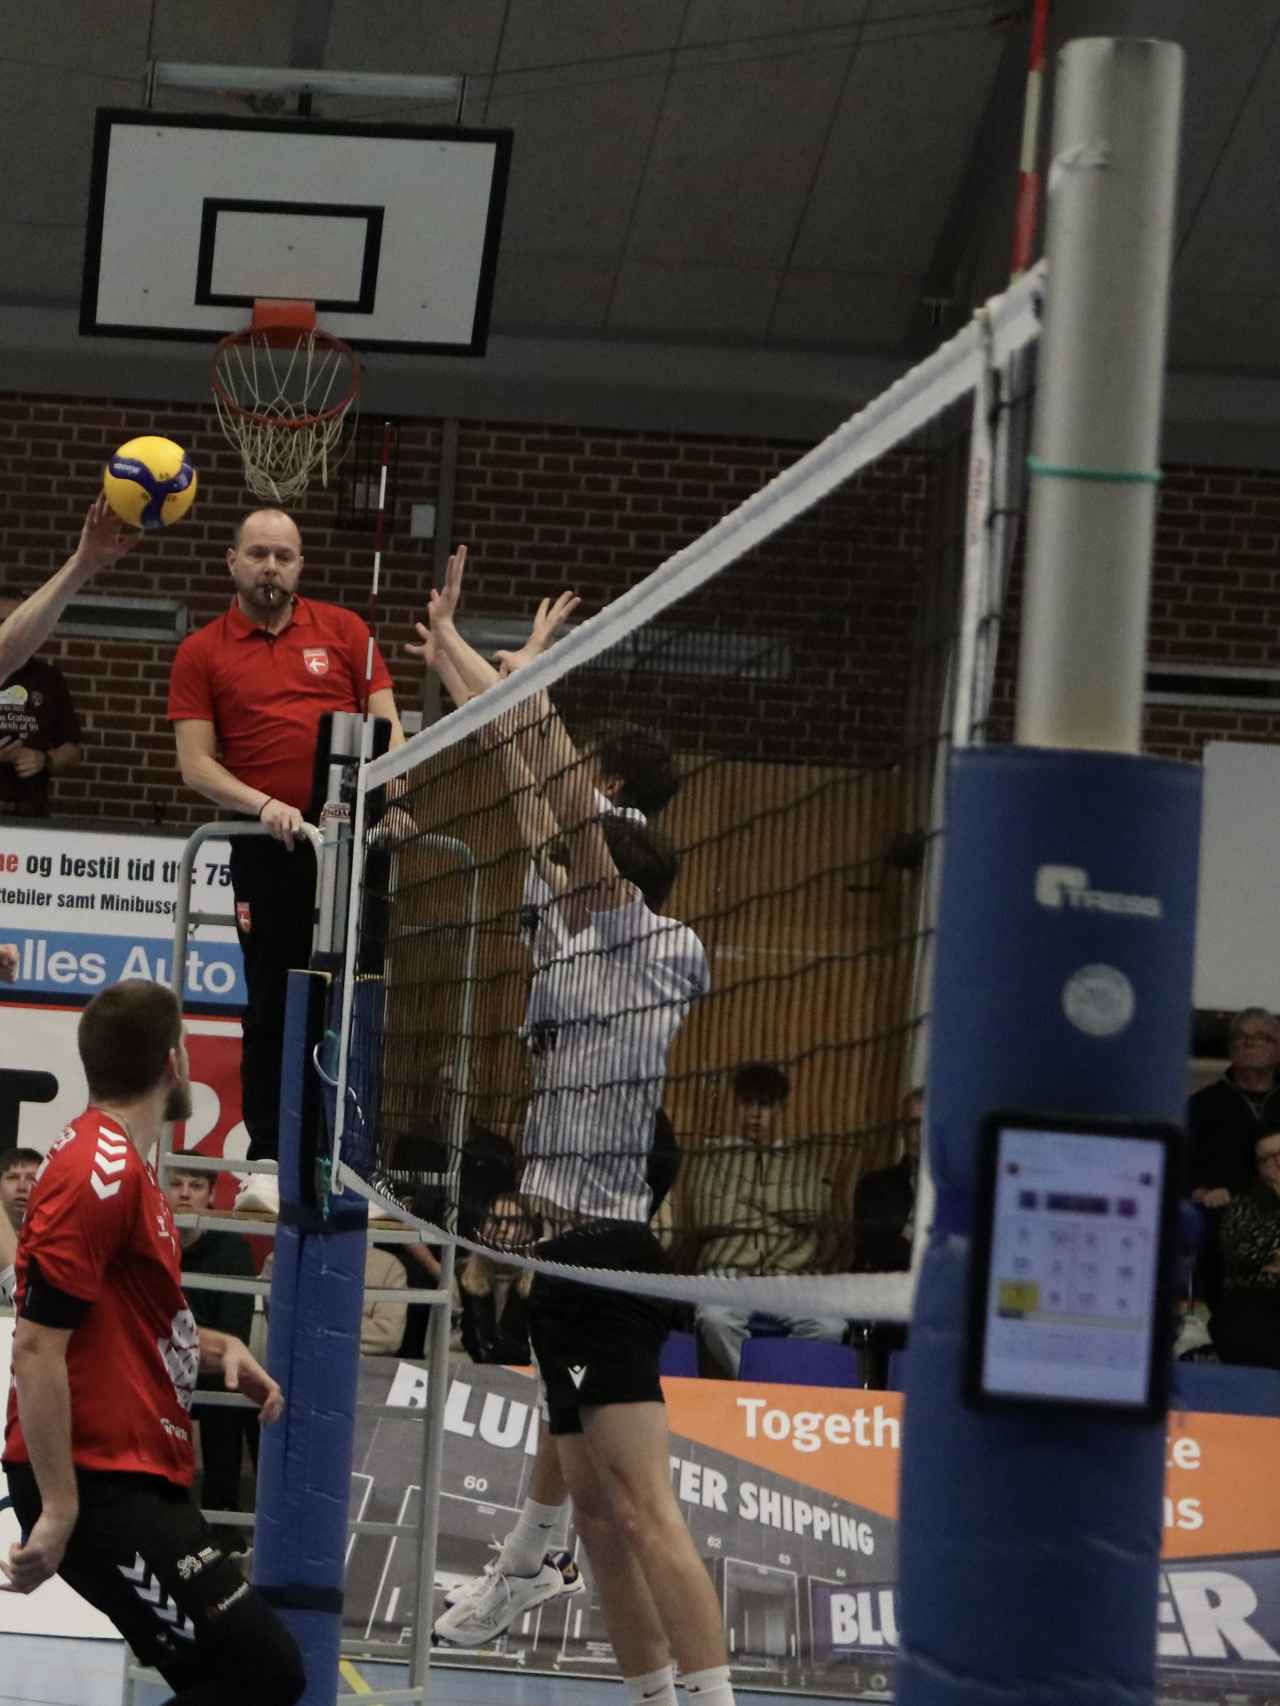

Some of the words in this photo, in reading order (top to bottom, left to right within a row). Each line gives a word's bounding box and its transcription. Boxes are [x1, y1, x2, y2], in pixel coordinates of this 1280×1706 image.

[26, 854, 51, 877] og
[60, 854, 119, 879] bestil
[127, 858, 154, 882] tid
[57, 893, 95, 911] samt
[463, 1475, 488, 1492] 60
[739, 1481, 874, 1556] SHIPPING
